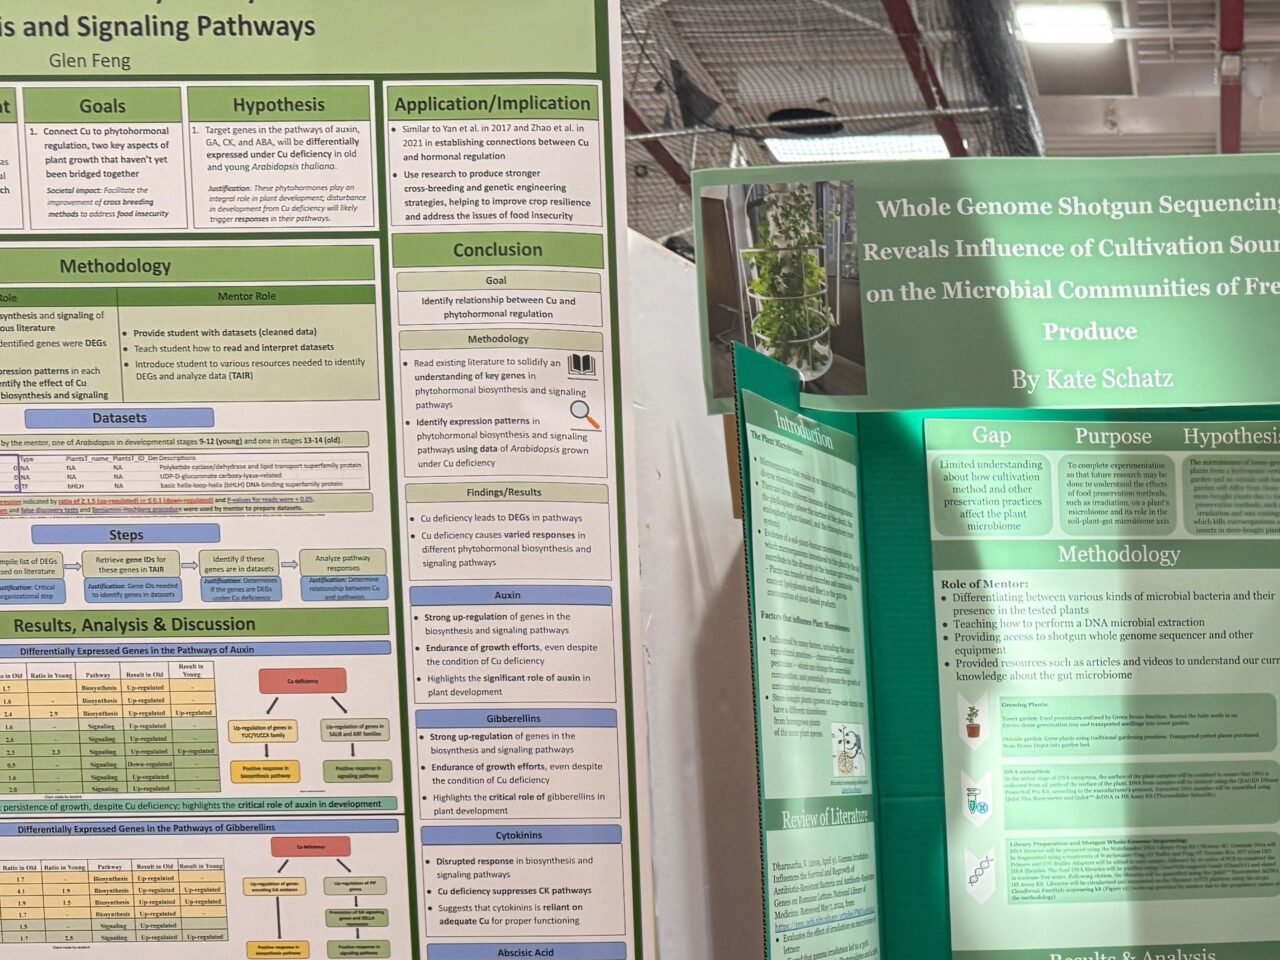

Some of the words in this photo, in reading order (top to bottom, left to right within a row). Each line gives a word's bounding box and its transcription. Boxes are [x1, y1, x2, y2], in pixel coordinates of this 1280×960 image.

[23, 15, 68, 36] and
[77, 15, 189, 41] Signaling
[197, 14, 315, 40] Pathways
[49, 52, 86, 67] Glen
[92, 53, 130, 70] Feng
[80, 98, 125, 112] Goals
[233, 97, 324, 114] Hypothesis
[394, 95, 590, 113] Application/Implication
[876, 197, 950, 217] Whole
[956, 197, 1052, 214] Genome
[1058, 196, 1153, 218] Shotgun
[453, 242, 542, 256] Conclusion
[862, 239, 948, 260] Reveals
[954, 238, 1064, 256] Influence
[1070, 238, 1094, 256] of
[1098, 236, 1224, 256] Cultivation
[60, 258, 170, 275] Methodology
[866, 288, 894, 302] on
[899, 282, 936, 300] the
[941, 280, 1052, 298] Microbial
[1058, 278, 1210, 298] Communities
[1216, 276, 1240, 295] of
[422, 297, 452, 306] Identify
[455, 296, 504, 307] relationship
[506, 296, 542, 304] between
[559, 297, 575, 305] and
[444, 310, 507, 319] phytohormonal
[510, 310, 553, 318] regulation
[200, 328, 220, 336] with
[222, 328, 256, 336] datasets
[258, 328, 293, 336] (cleaned
[295, 327, 316, 336] data)
[1042, 321, 1137, 340] Produce
[1011, 369, 1040, 394] By
[1047, 370, 1096, 387] Kate
[1102, 367, 1173, 387] Schatz
[92, 412, 147, 424] Datasets
[774, 410, 834, 450] Introduction
[972, 426, 1012, 446] Gap
[1075, 428, 1152, 448] Purpose
[1058, 544, 1180, 566] Methodology
[495, 591, 520, 599] Auxin
[14, 618, 77, 634] Results,
[82, 618, 149, 634] Analysis
[153, 618, 166, 630] &
[172, 617, 255, 631] Discussion
[20, 646, 75, 656] Differentially
[77, 646, 120, 656] Expressed
[122, 646, 148, 654] Genes
[150, 646, 158, 654] in
[160, 646, 175, 654] the
[177, 646, 217, 656] Pathways
[219, 645, 228, 654] of
[230, 646, 254, 654] Auxin
[486, 713, 542, 724] Gibberellins
[782, 810, 818, 828] Review
[820, 808, 829, 825] of
[830, 808, 868, 825] Literature
[495, 830, 543, 842] Cytokinins
[498, 949, 532, 957] Abscisic
[535, 949, 554, 957] Acid
